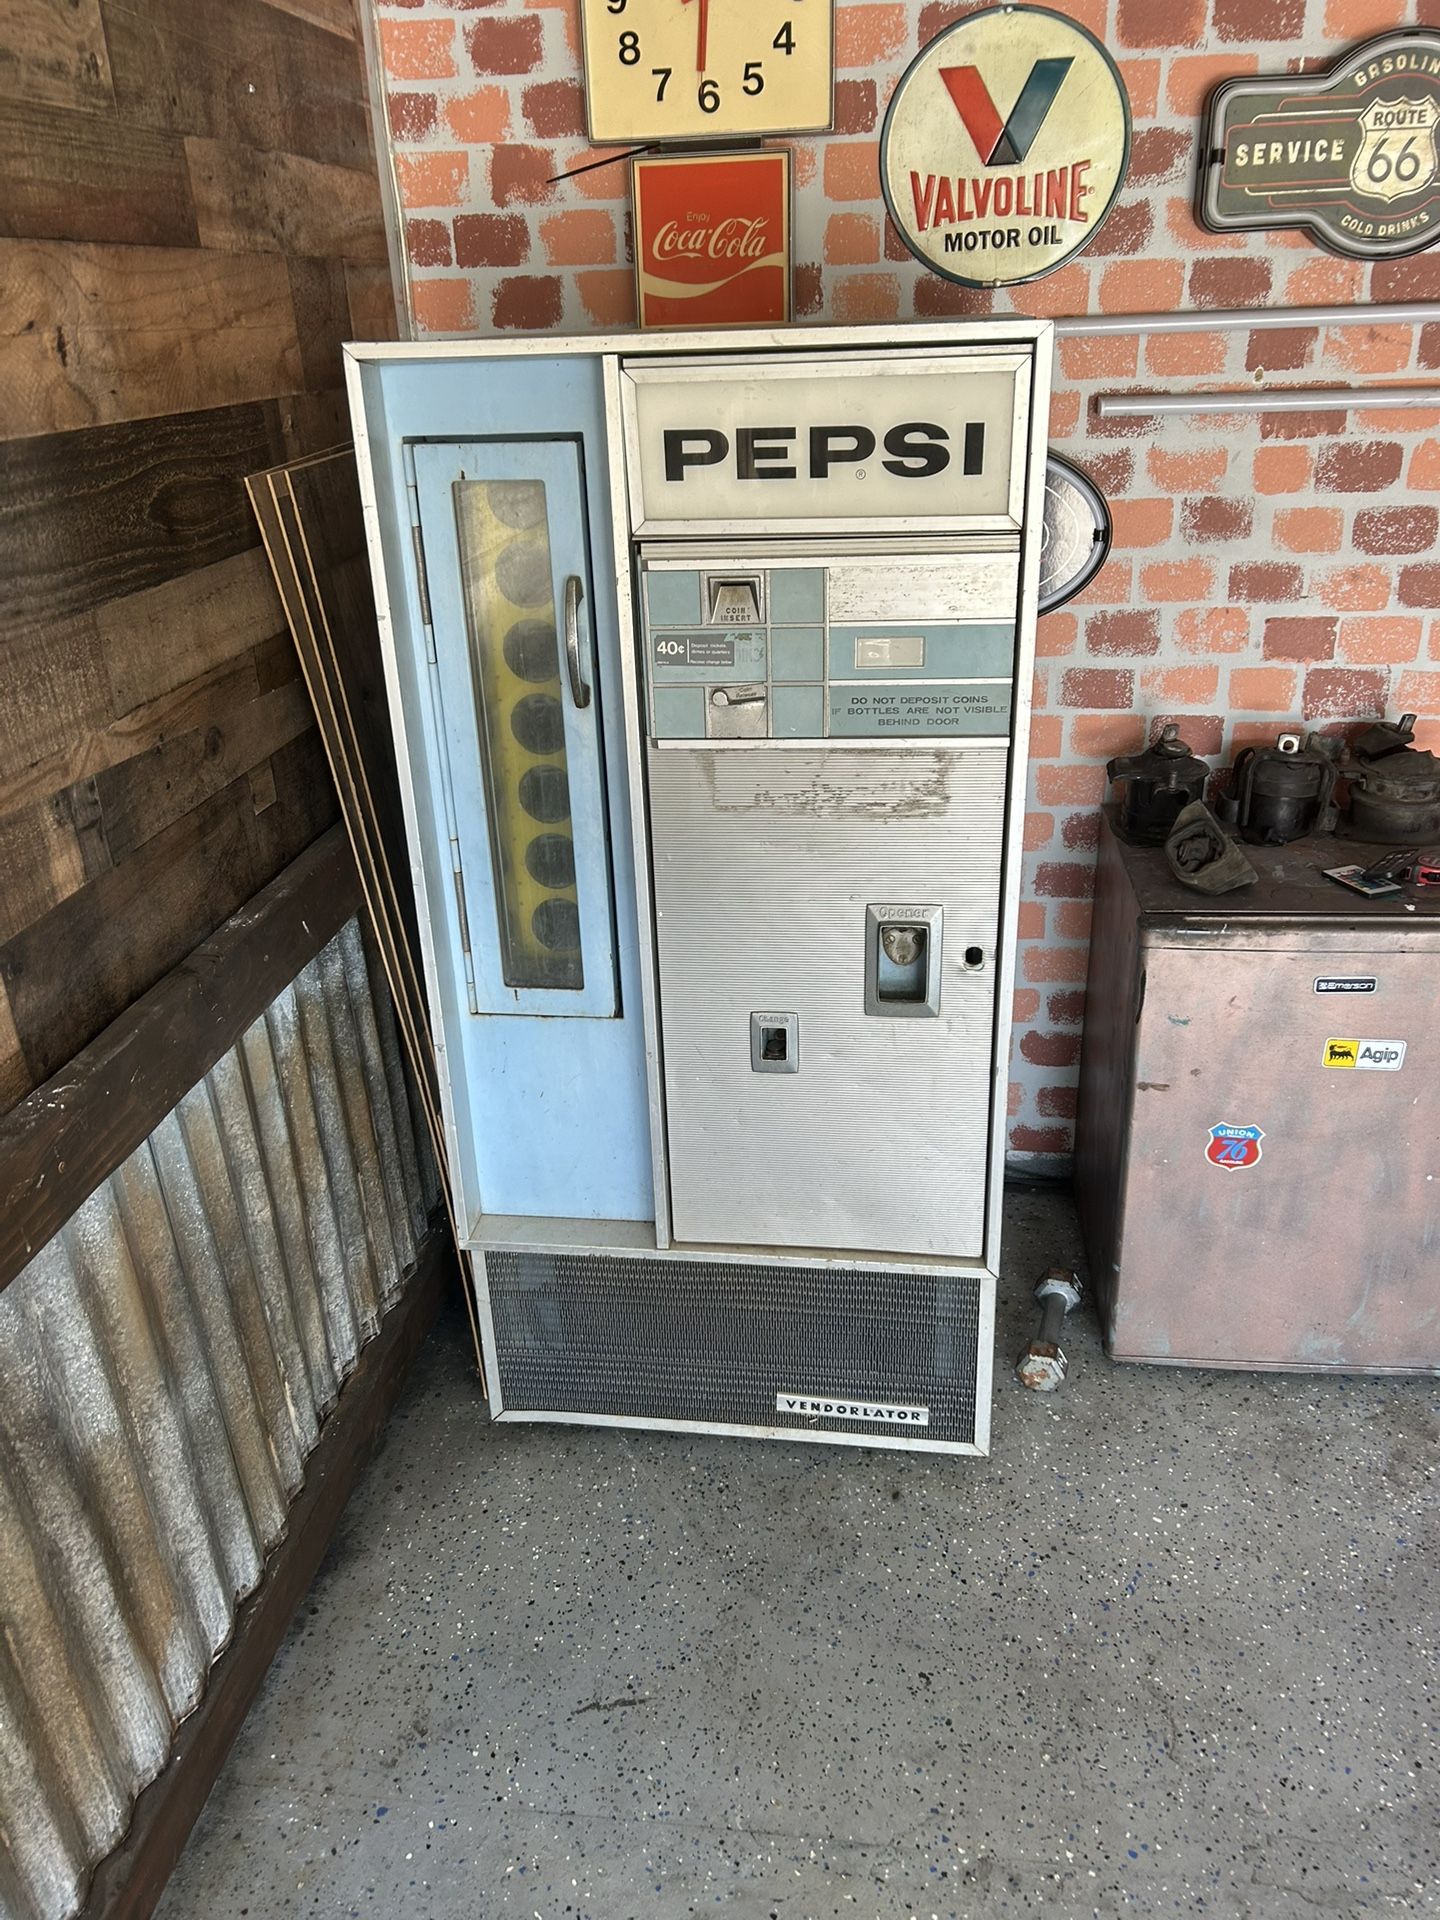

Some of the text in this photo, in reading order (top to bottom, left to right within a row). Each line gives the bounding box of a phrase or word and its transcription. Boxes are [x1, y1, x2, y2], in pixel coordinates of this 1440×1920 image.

[618, 31, 641, 65] 8
[772, 20, 796, 56] 4
[651, 67, 672, 102] 7
[742, 62, 765, 95] 5
[698, 80, 720, 113] 6
[1373, 108, 1428, 126] ROUTE
[1235, 138, 1345, 167] SERVICE
[1367, 136, 1420, 183] 66
[909, 159, 1092, 233] VALVOLINE
[1340, 211, 1430, 237] COLD DRINKS
[652, 216, 770, 261] Coca-Cola
[944, 225, 1063, 253] MOTOR OIL
[663, 421, 986, 482] PEPSI
[831, 705, 1008, 716] IF BOTTLES ARE NOT VISIBLE
[851, 695, 989, 705] DO NOT DEPOSIT COINS
[877, 716, 960, 727] BEHIND DOOR
[878, 906, 930, 919] Opener
[1327, 982, 1374, 990] Emerson
[758, 1014, 790, 1025] Change
[1359, 1046, 1400, 1063] Agip
[1218, 1129, 1255, 1138] UNION
[1215, 1139, 1249, 1160] 76
[786, 1400, 921, 1421] VENDORLATOR
